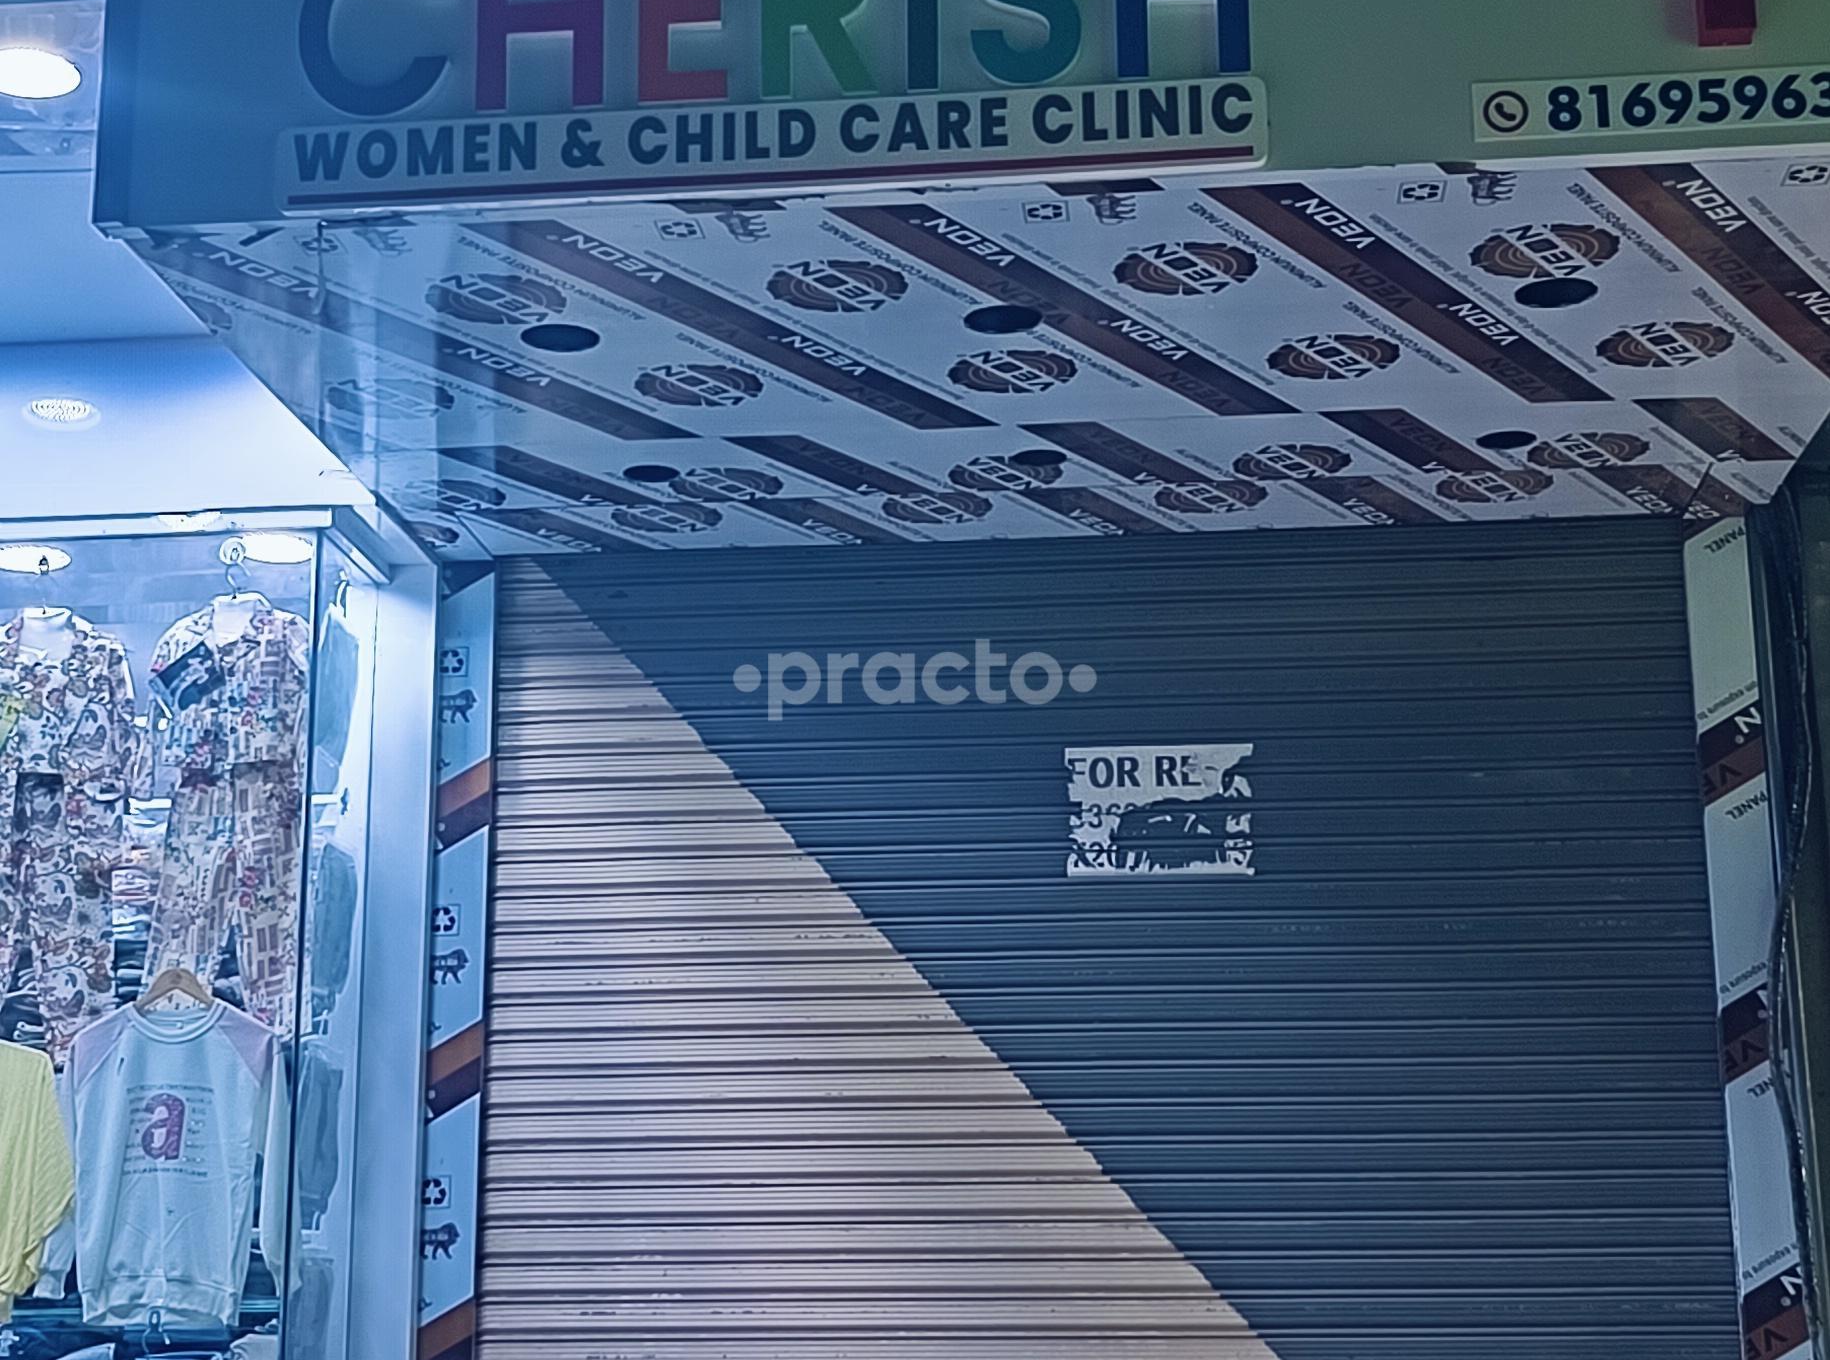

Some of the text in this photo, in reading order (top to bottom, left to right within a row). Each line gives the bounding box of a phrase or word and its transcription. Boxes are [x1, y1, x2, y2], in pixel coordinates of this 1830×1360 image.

[1547, 71, 1830, 132] 81695963
[294, 82, 1256, 183] WOMEN & CHILD CARE CLINIC
[1295, 198, 1376, 248] VEON
[1676, 179, 1746, 232] VEON
[562, 234, 664, 283] VEON
[924, 218, 1015, 266] VEON
[1506, 224, 1587, 277] VEON
[209, 251, 320, 299] VEON
[787, 261, 886, 311] VEON
[1141, 243, 1232, 294] VEON
[440, 274, 549, 322] VEON
[1109, 319, 1190, 361] VEON
[1450, 303, 1520, 346] VEON
[1631, 322, 1702, 367] VEON
[457, 346, 551, 386] VEON
[782, 335, 867, 376] VEON
[970, 350, 1055, 392] VEON
[1296, 335, 1374, 379] VEON
[652, 364, 745, 406] VEON
[1703, 526, 1745, 553] PANEL
[1067, 754, 1214, 789] FOR RE
[1747, 1076, 1775, 1098] NEL
